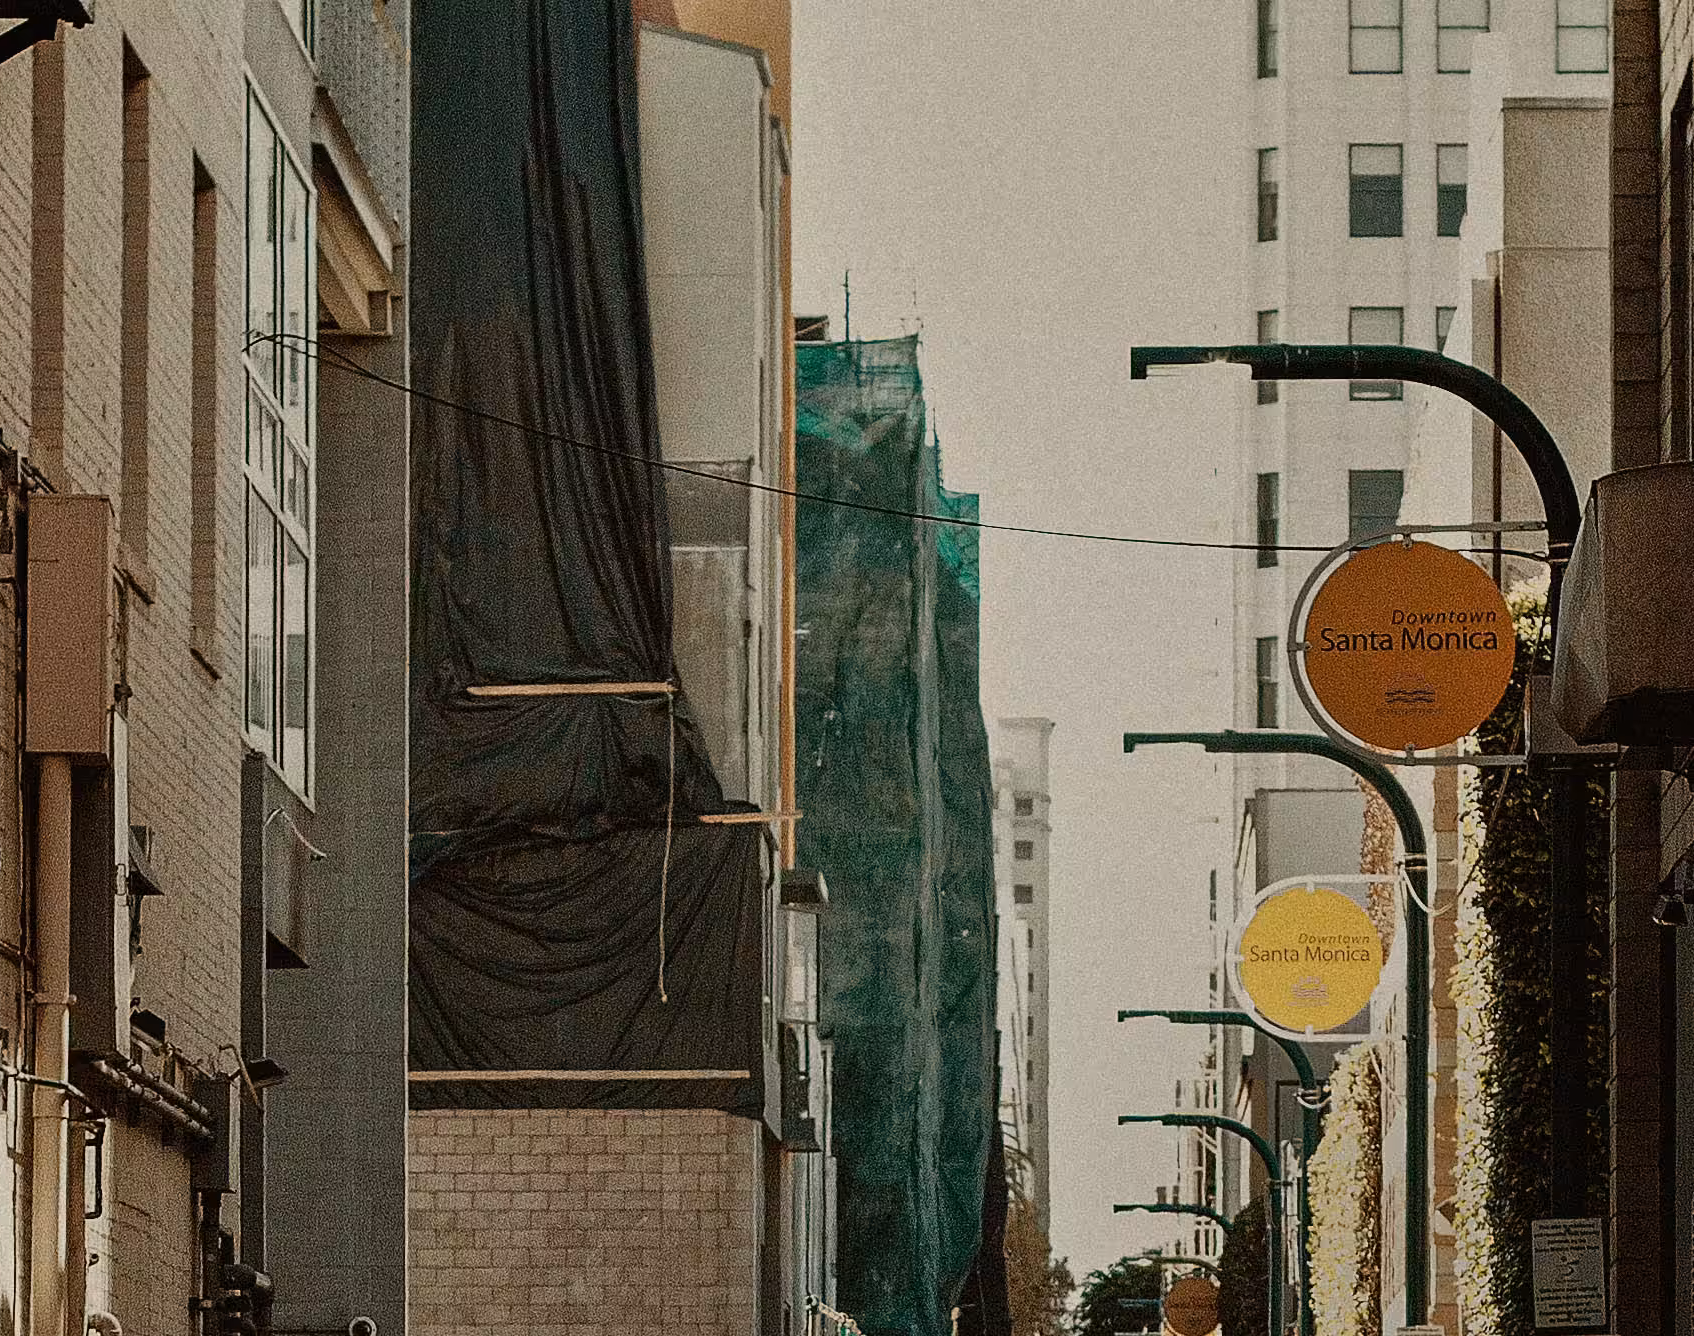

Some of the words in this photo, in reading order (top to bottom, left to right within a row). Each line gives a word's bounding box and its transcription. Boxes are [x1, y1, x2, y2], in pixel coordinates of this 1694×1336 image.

[1392, 610, 1496, 625] Downtown
[1320, 627, 1393, 651] Santa
[1402, 627, 1497, 651] Monica
[1298, 933, 1370, 944] Downtown
[1250, 945, 1299, 962] Santa
[1305, 945, 1370, 962] Monica
